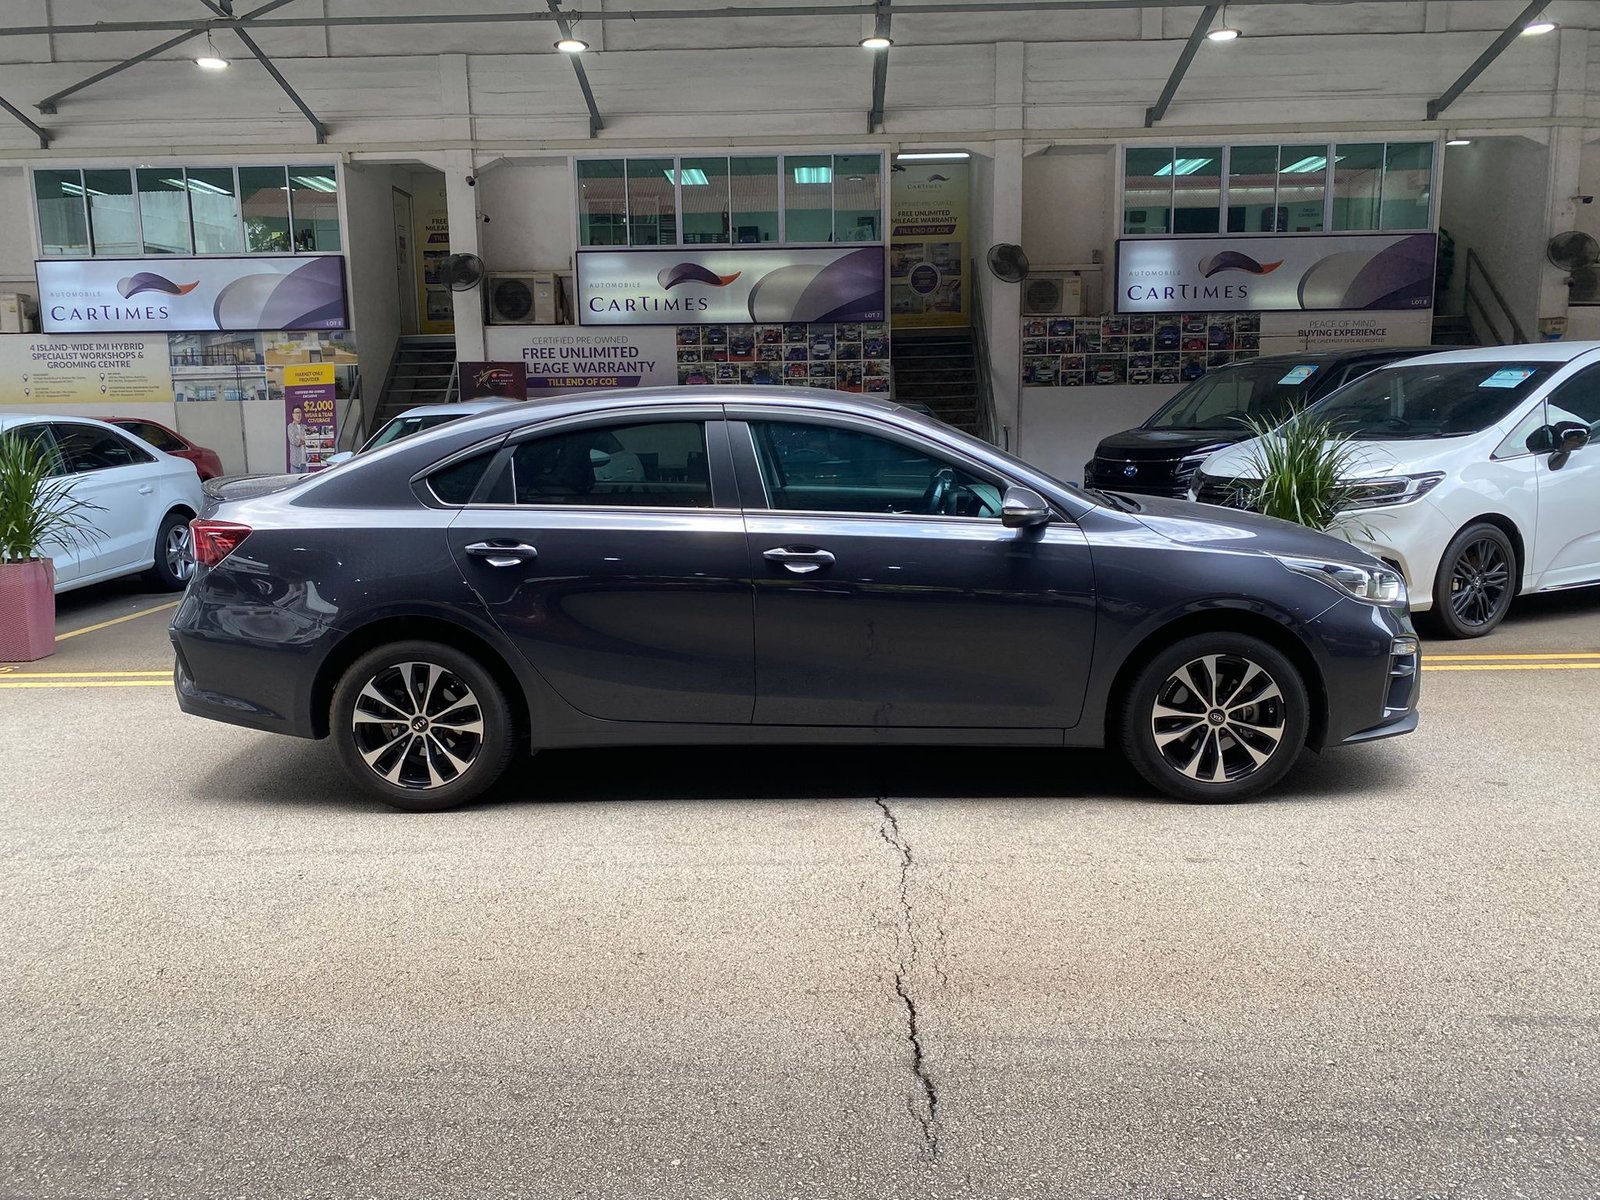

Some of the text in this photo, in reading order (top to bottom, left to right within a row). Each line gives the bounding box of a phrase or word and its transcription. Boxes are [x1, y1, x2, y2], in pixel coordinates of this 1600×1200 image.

[1310, 320, 1376, 328] PEACE OF MIND
[1298, 328, 1387, 337] BUYING EXPERIENCE
[532, 336, 628, 344] CERTIFIED PRE-OWNED
[36, 344, 94, 352] ISLAND-WIDE
[112, 342, 144, 350] HYBRID
[522, 346, 639, 359] FREE UNLIMITED
[526, 360, 655, 374] LEAGE WARRANTY
[599, 378, 618, 386] COE
[304, 400, 333, 412] $2,000
